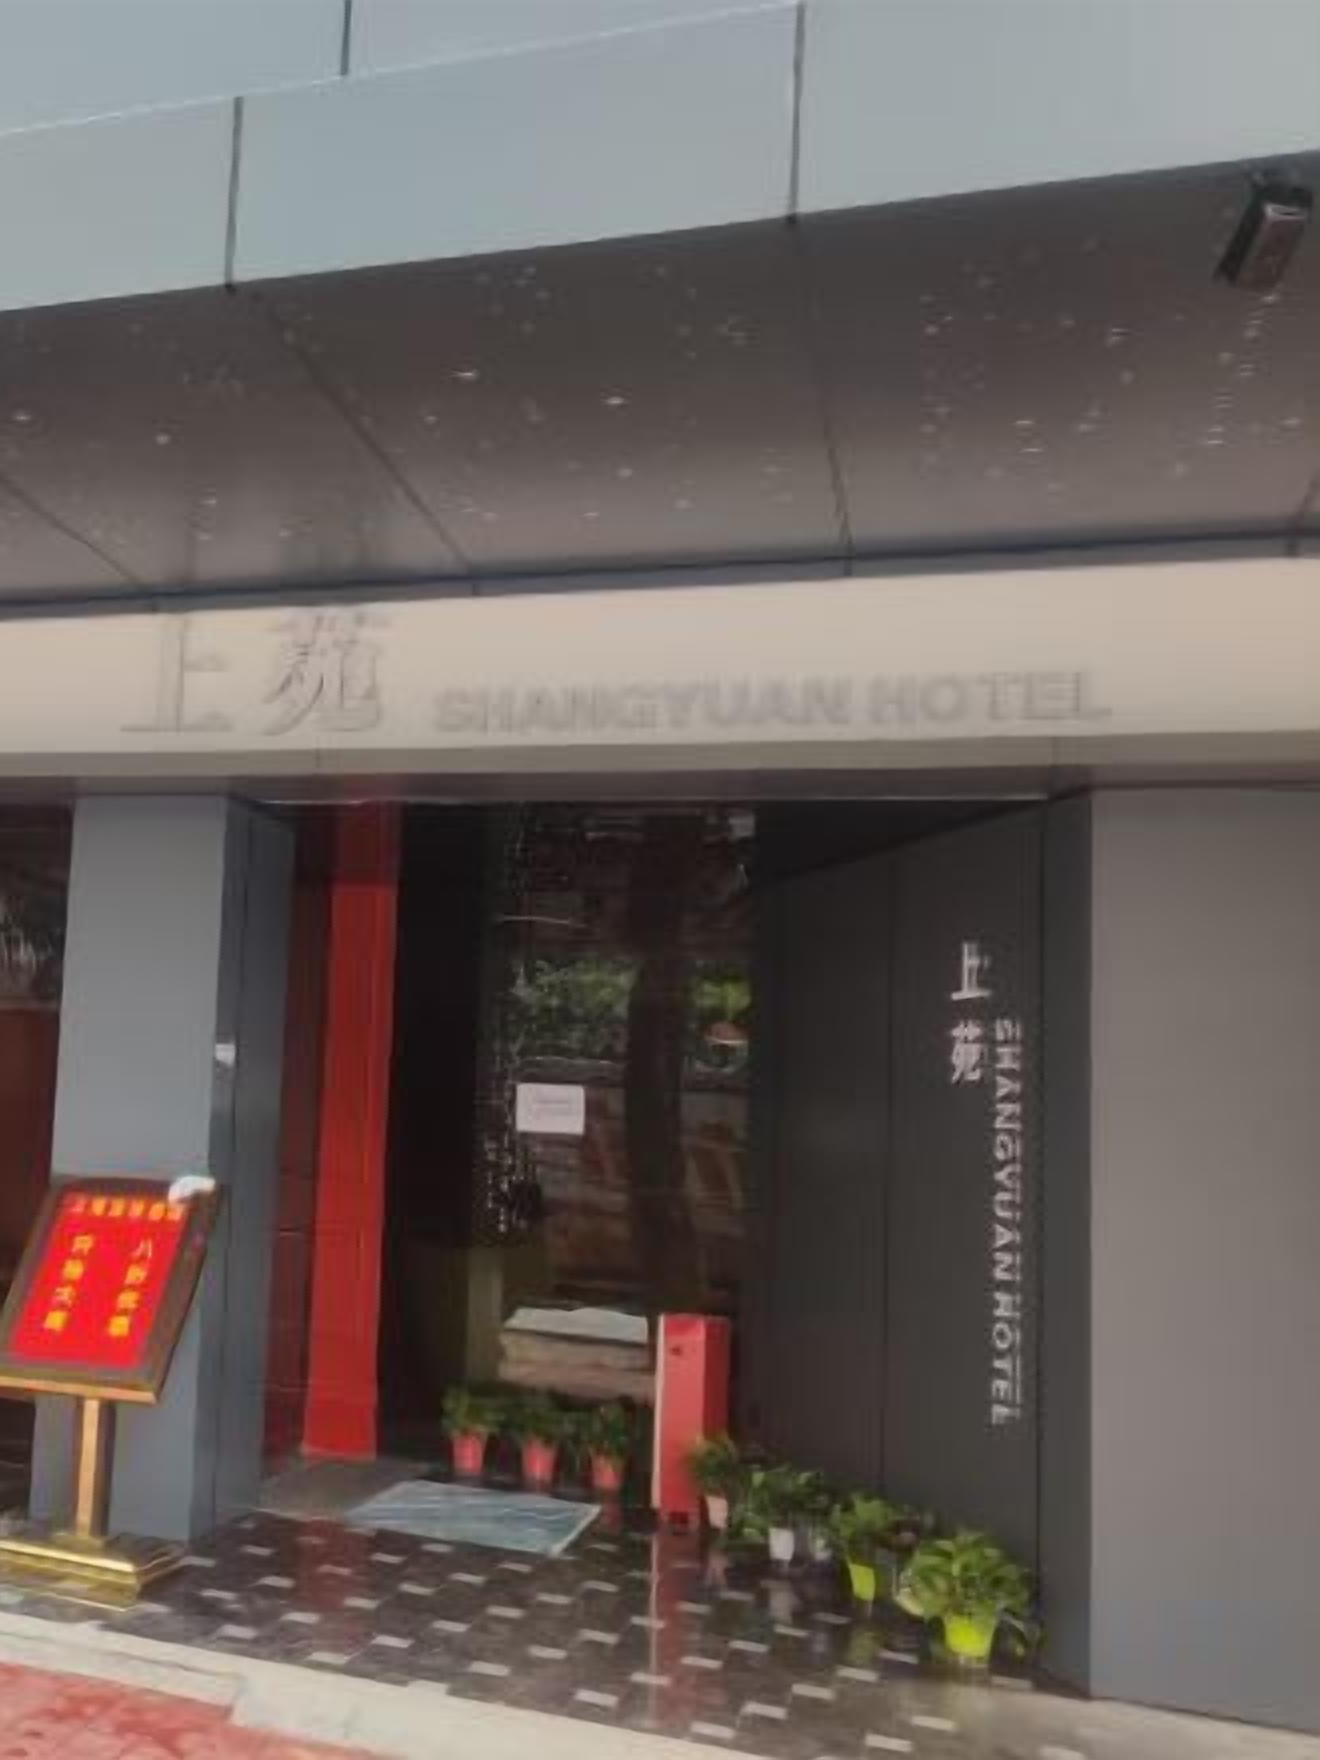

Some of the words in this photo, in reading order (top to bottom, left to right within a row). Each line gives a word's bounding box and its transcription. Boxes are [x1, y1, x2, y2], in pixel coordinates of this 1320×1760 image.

[121, 609, 391, 736] 上苑
[433, 674, 852, 733] SHANGYUAN
[866, 669, 1113, 723] HOTEL
[993, 1018, 1023, 1282] SHANGYUAN
[991, 1291, 1022, 1425] HOTEL
